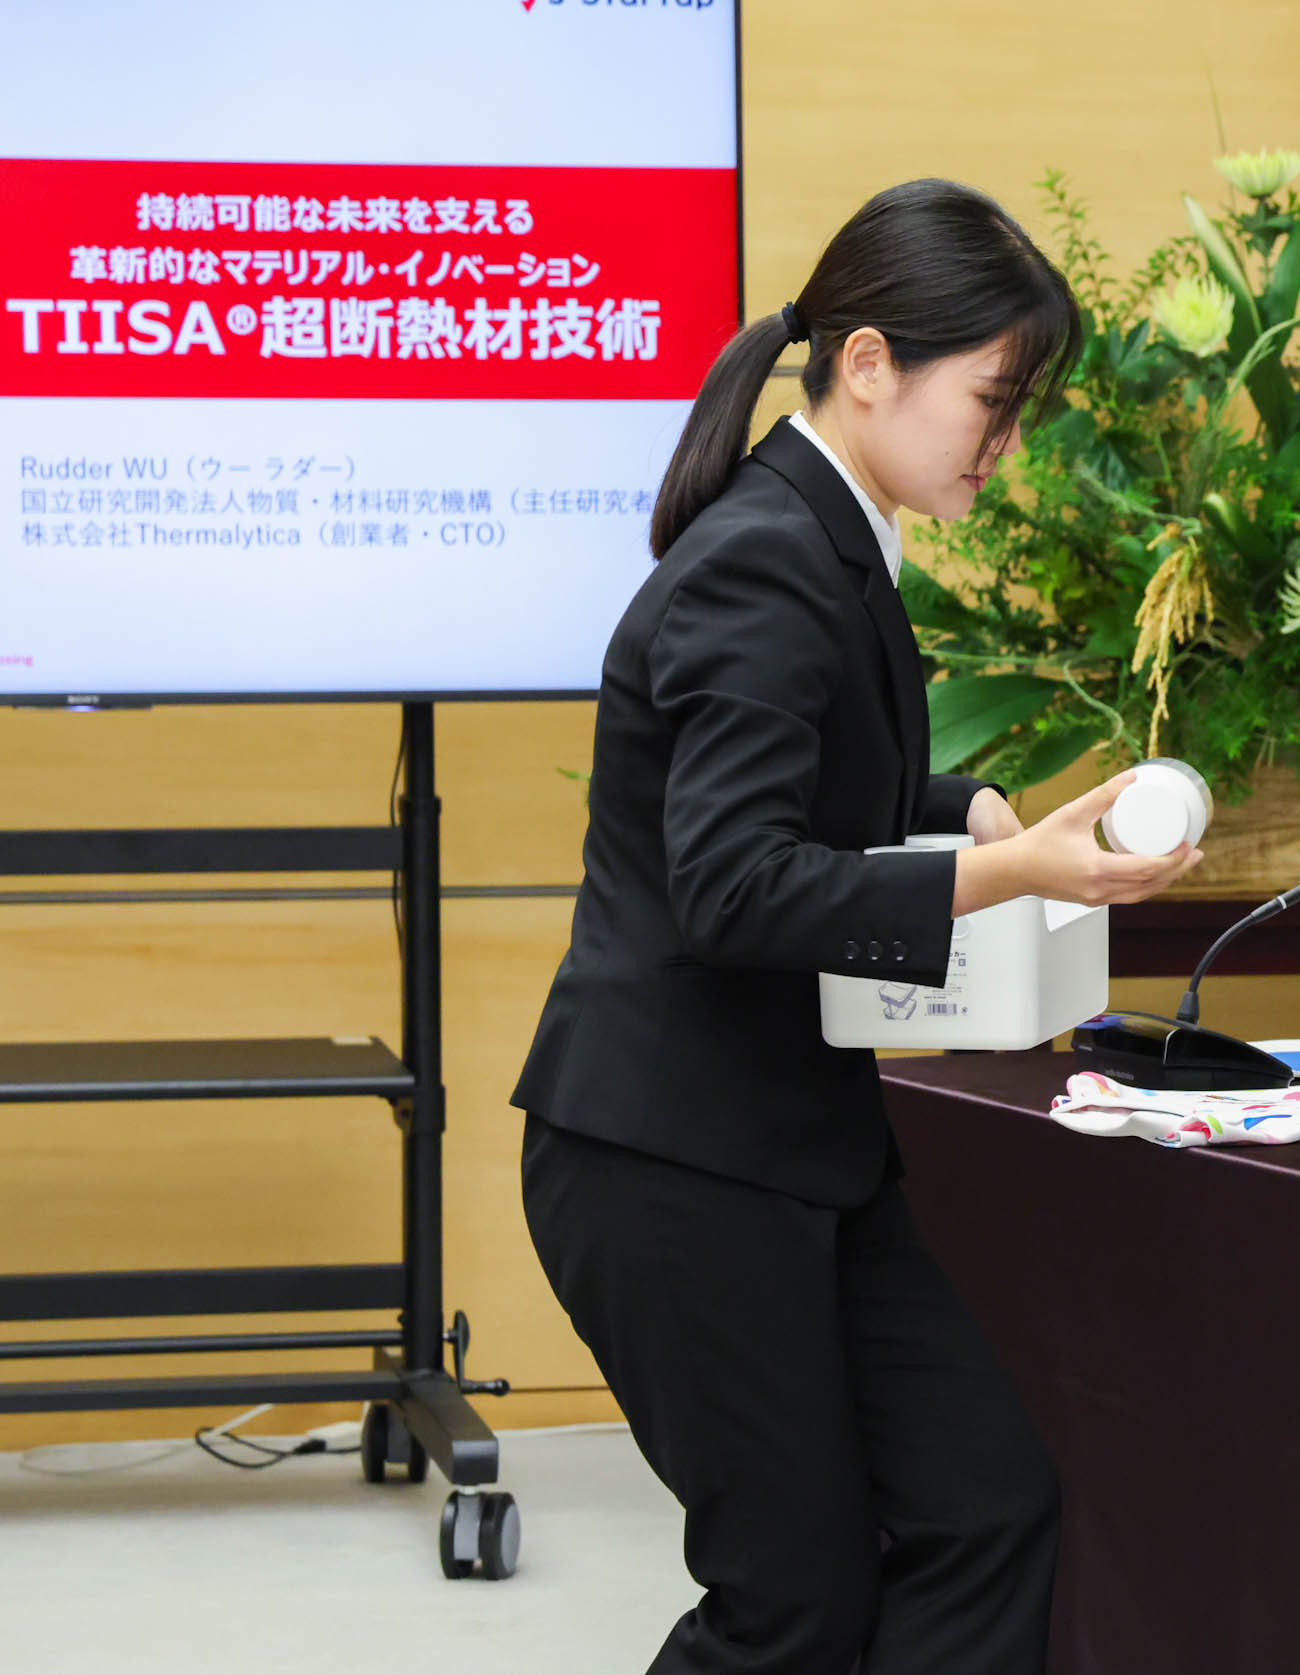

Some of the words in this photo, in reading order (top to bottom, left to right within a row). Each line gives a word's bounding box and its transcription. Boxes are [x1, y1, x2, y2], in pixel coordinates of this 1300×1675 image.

[136, 192, 534, 235] 持続可能な未来を支える
[69, 245, 601, 287] 革新的なマテリアル・イノベーション
[20, 456, 113, 482] Rudder
